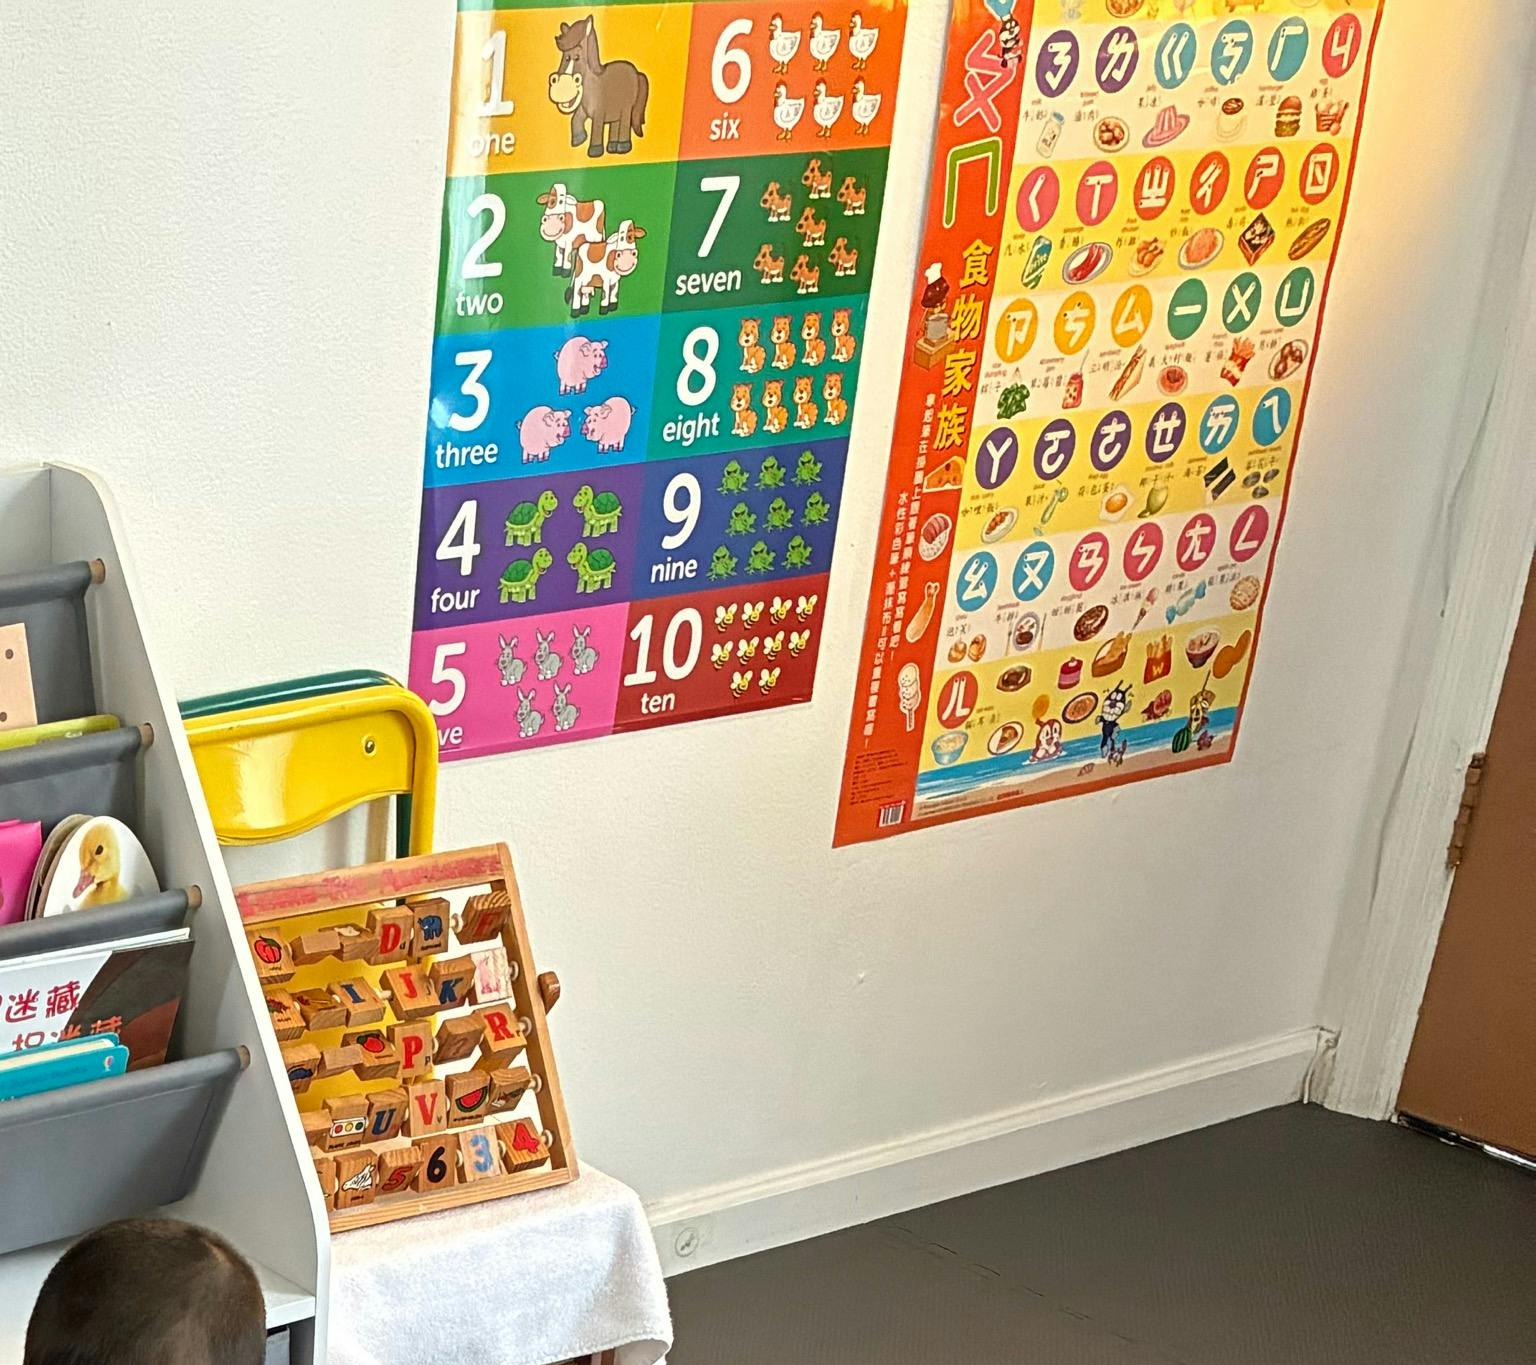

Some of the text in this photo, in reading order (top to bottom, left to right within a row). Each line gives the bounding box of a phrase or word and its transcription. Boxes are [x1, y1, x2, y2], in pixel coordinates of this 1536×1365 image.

[471, 30, 515, 118] 1
[709, 17, 753, 104] 6
[709, 113, 741, 141] six
[469, 130, 515, 157] one
[699, 176, 741, 258] 7
[463, 193, 507, 280] 2
[675, 268, 742, 297] seven
[455, 289, 504, 316] two
[933, 239, 995, 451] 食物家族
[675, 326, 721, 406] 8
[448, 350, 494, 432] 3
[662, 411, 721, 443] eight
[434, 438, 499, 468] three
[661, 473, 702, 551] 9
[435, 499, 480, 577] 4
[650, 555, 698, 584] nine
[430, 585, 481, 613] four
[623, 607, 702, 687] 10
[428, 641, 467, 716] 5
[640, 688, 675, 714] ten
[380, 923, 401, 954] D
[340, 983, 366, 1004] I
[399, 973, 418, 999] J
[439, 977, 464, 1005] K
[484, 1011, 514, 1042] R
[402, 1035, 424, 1069] P
[372, 1108, 396, 1136] U
[415, 1092, 439, 1126] V
[469, 1134, 492, 1173] 3
[512, 1122, 541, 1154] 4
[381, 1166, 413, 1191] 5
[426, 1146, 448, 1184] 6
